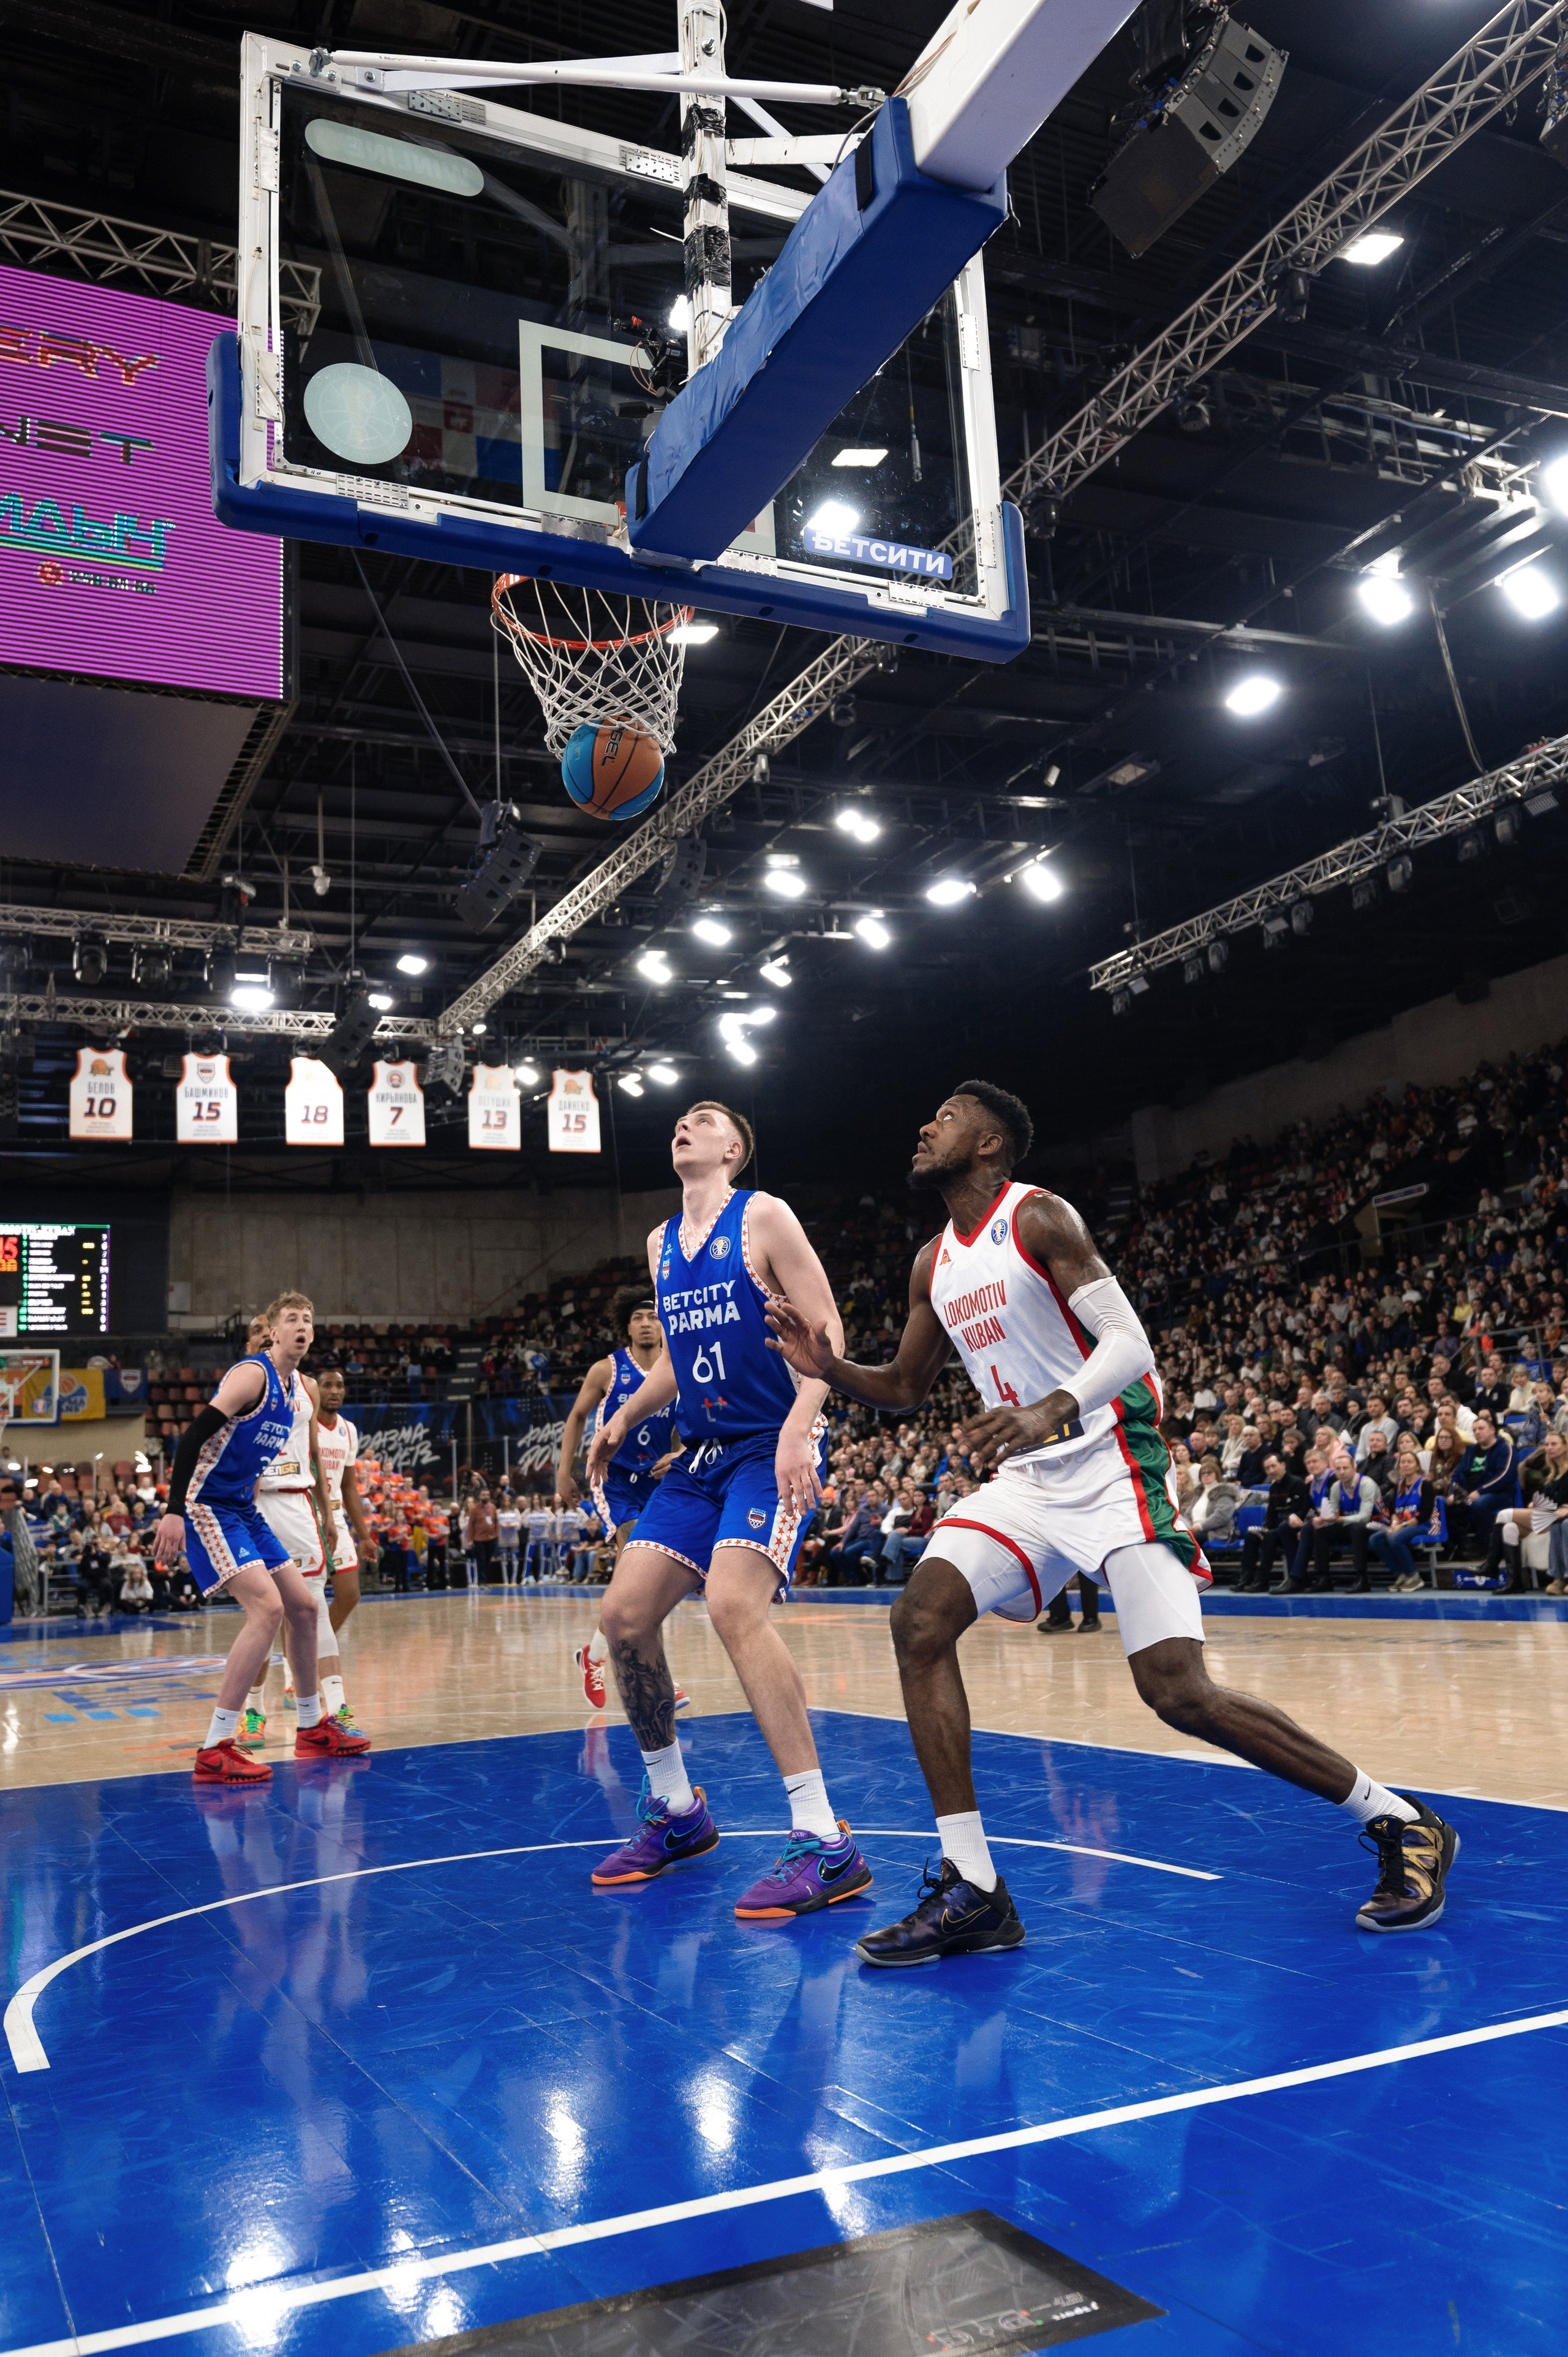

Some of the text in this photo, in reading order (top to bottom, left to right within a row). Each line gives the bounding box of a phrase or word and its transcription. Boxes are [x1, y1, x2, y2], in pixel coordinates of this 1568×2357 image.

[812, 531, 944, 574] БЕТСИТИ
[88, 1081, 115, 1094] БЕЛОВ
[185, 1086, 228, 1098] БАШМИНОВ
[376, 1092, 418, 1103] КИРЬЯНОВА
[84, 1097, 116, 1119] 10
[193, 1101, 221, 1121] 15
[301, 1105, 329, 1124] 18
[390, 1106, 404, 1126] 7
[482, 1110, 508, 1130] 13
[562, 1113, 587, 1133] 15
[663, 1280, 736, 1312] BETCITY
[943, 1280, 1007, 1328] LOKOMOTIV
[668, 1301, 741, 1336] PARMA
[961, 1315, 1006, 1353] KUBAN
[692, 1341, 726, 1383] 61
[990, 1364, 1021, 1407] 4
[638, 1425, 650, 1445] 6
